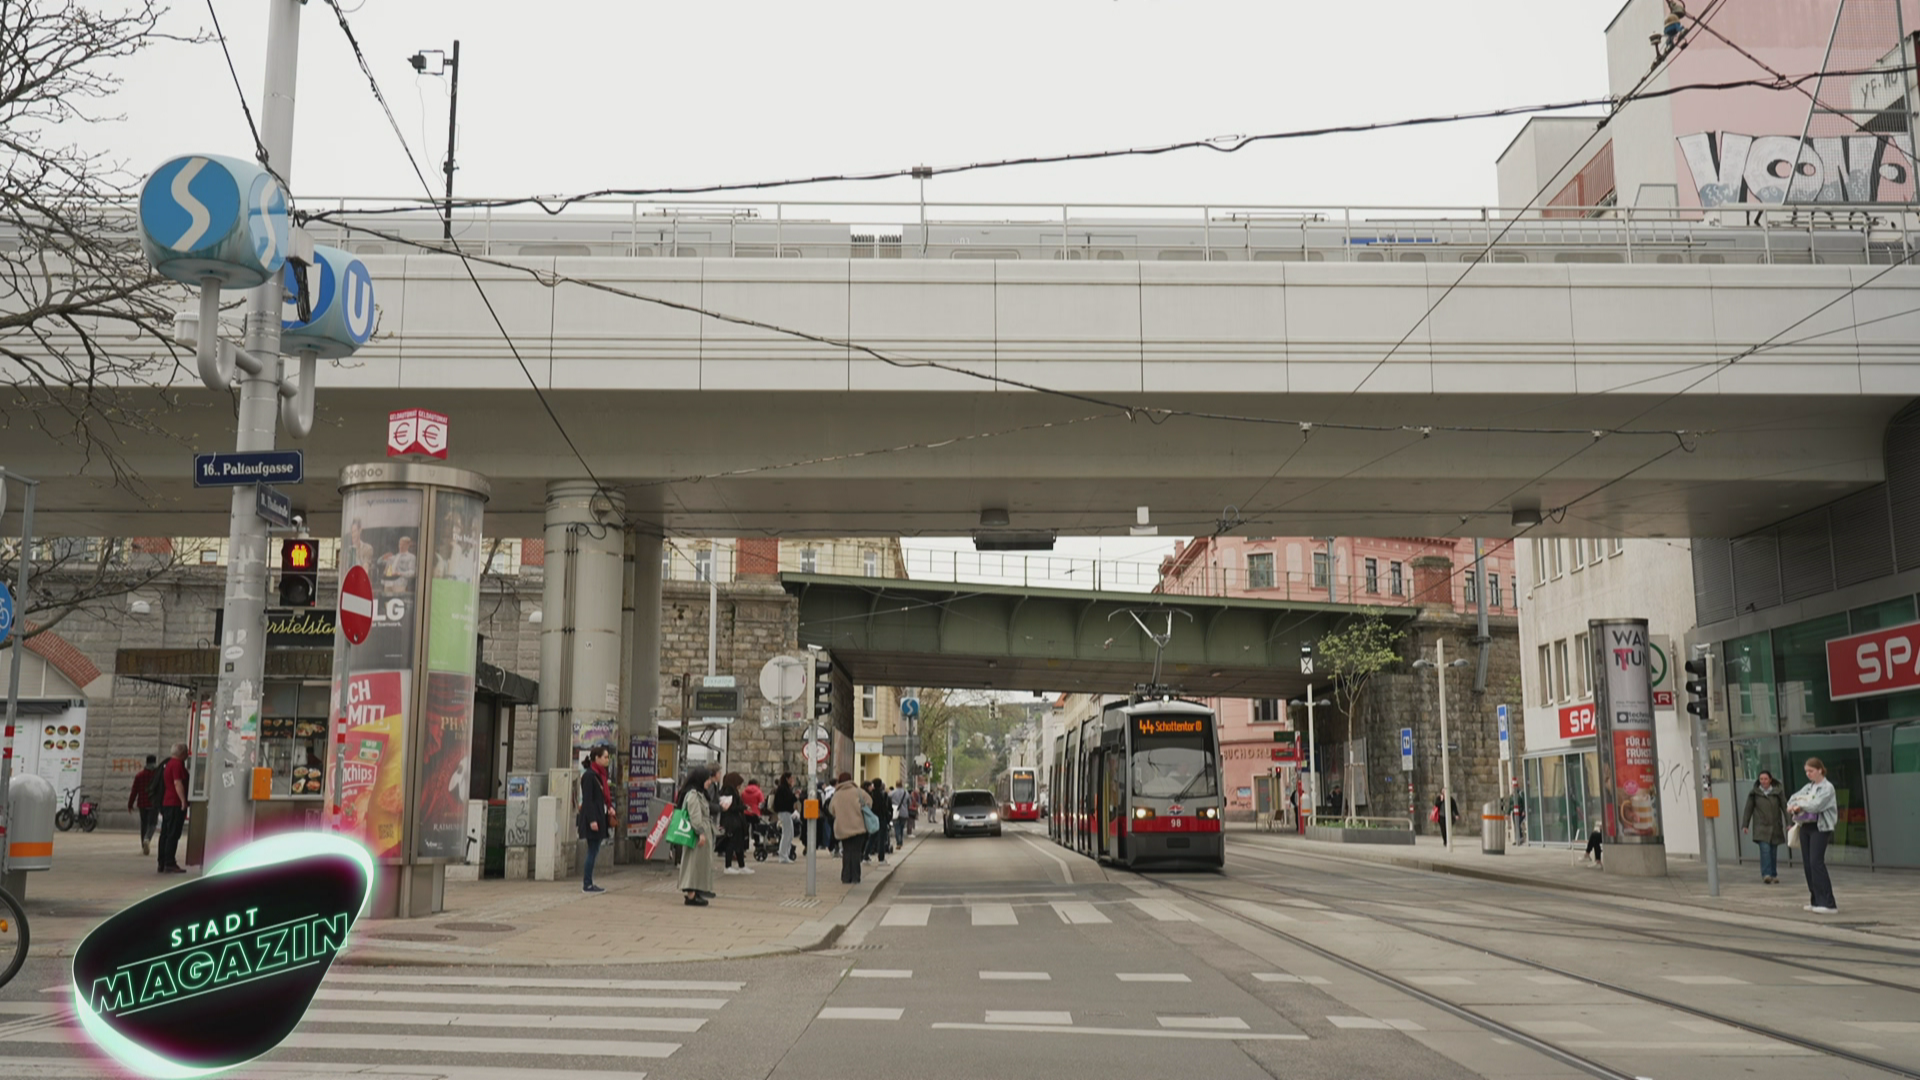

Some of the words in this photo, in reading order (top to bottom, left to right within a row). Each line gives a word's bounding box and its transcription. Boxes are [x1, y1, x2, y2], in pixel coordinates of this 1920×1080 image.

[389, 410, 417, 421] GELDAUTOMAT
[418, 410, 448, 424] GELDAUTOMAT
[223, 462, 293, 477] Paltaufgasse
[1856, 635, 1920, 685] SP
[347, 679, 371, 704] CH
[348, 704, 386, 727] MIT!
[1139, 719, 1155, 734] 44
[1155, 720, 1195, 732] Schottentor
[1171, 818, 1181, 828] 98
